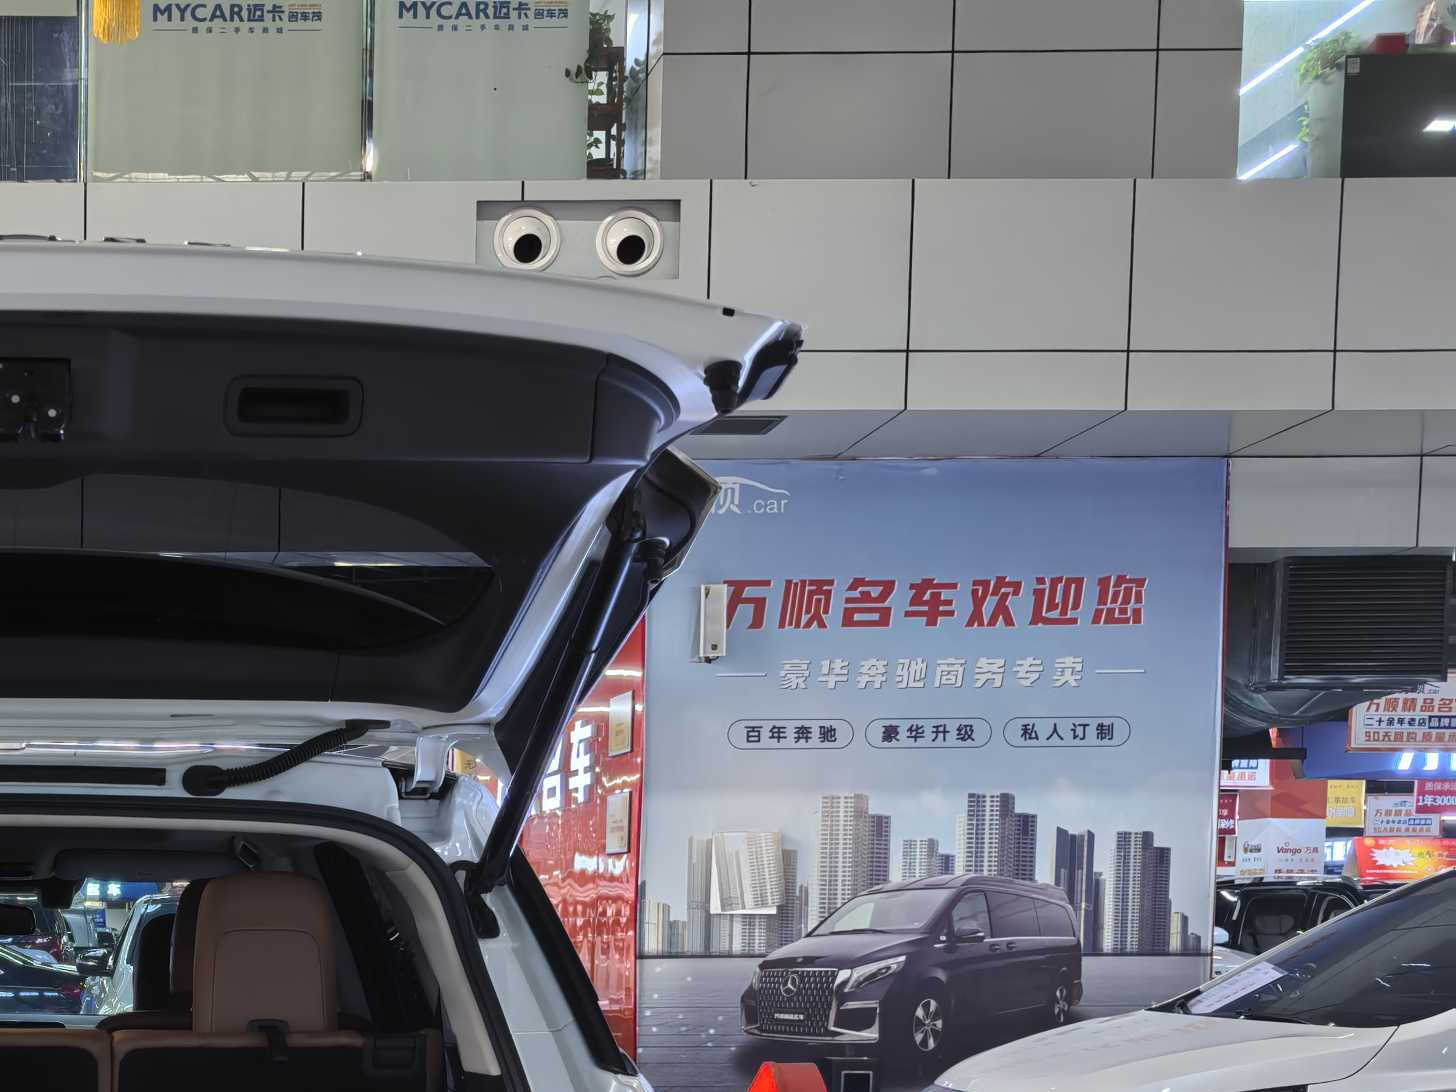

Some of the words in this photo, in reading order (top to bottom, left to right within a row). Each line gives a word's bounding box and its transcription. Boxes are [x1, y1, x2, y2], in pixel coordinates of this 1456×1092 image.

[723, 575, 1148, 630] 万顺名车欢迎您
[778, 656, 1085, 690] 豪华奔驰商务专卖
[1364, 697, 1456, 713] 万顺精品名
[745, 725, 838, 744] 百年奔驰
[881, 723, 976, 743] 豪华升级
[1020, 722, 1115, 742] 私人订制
